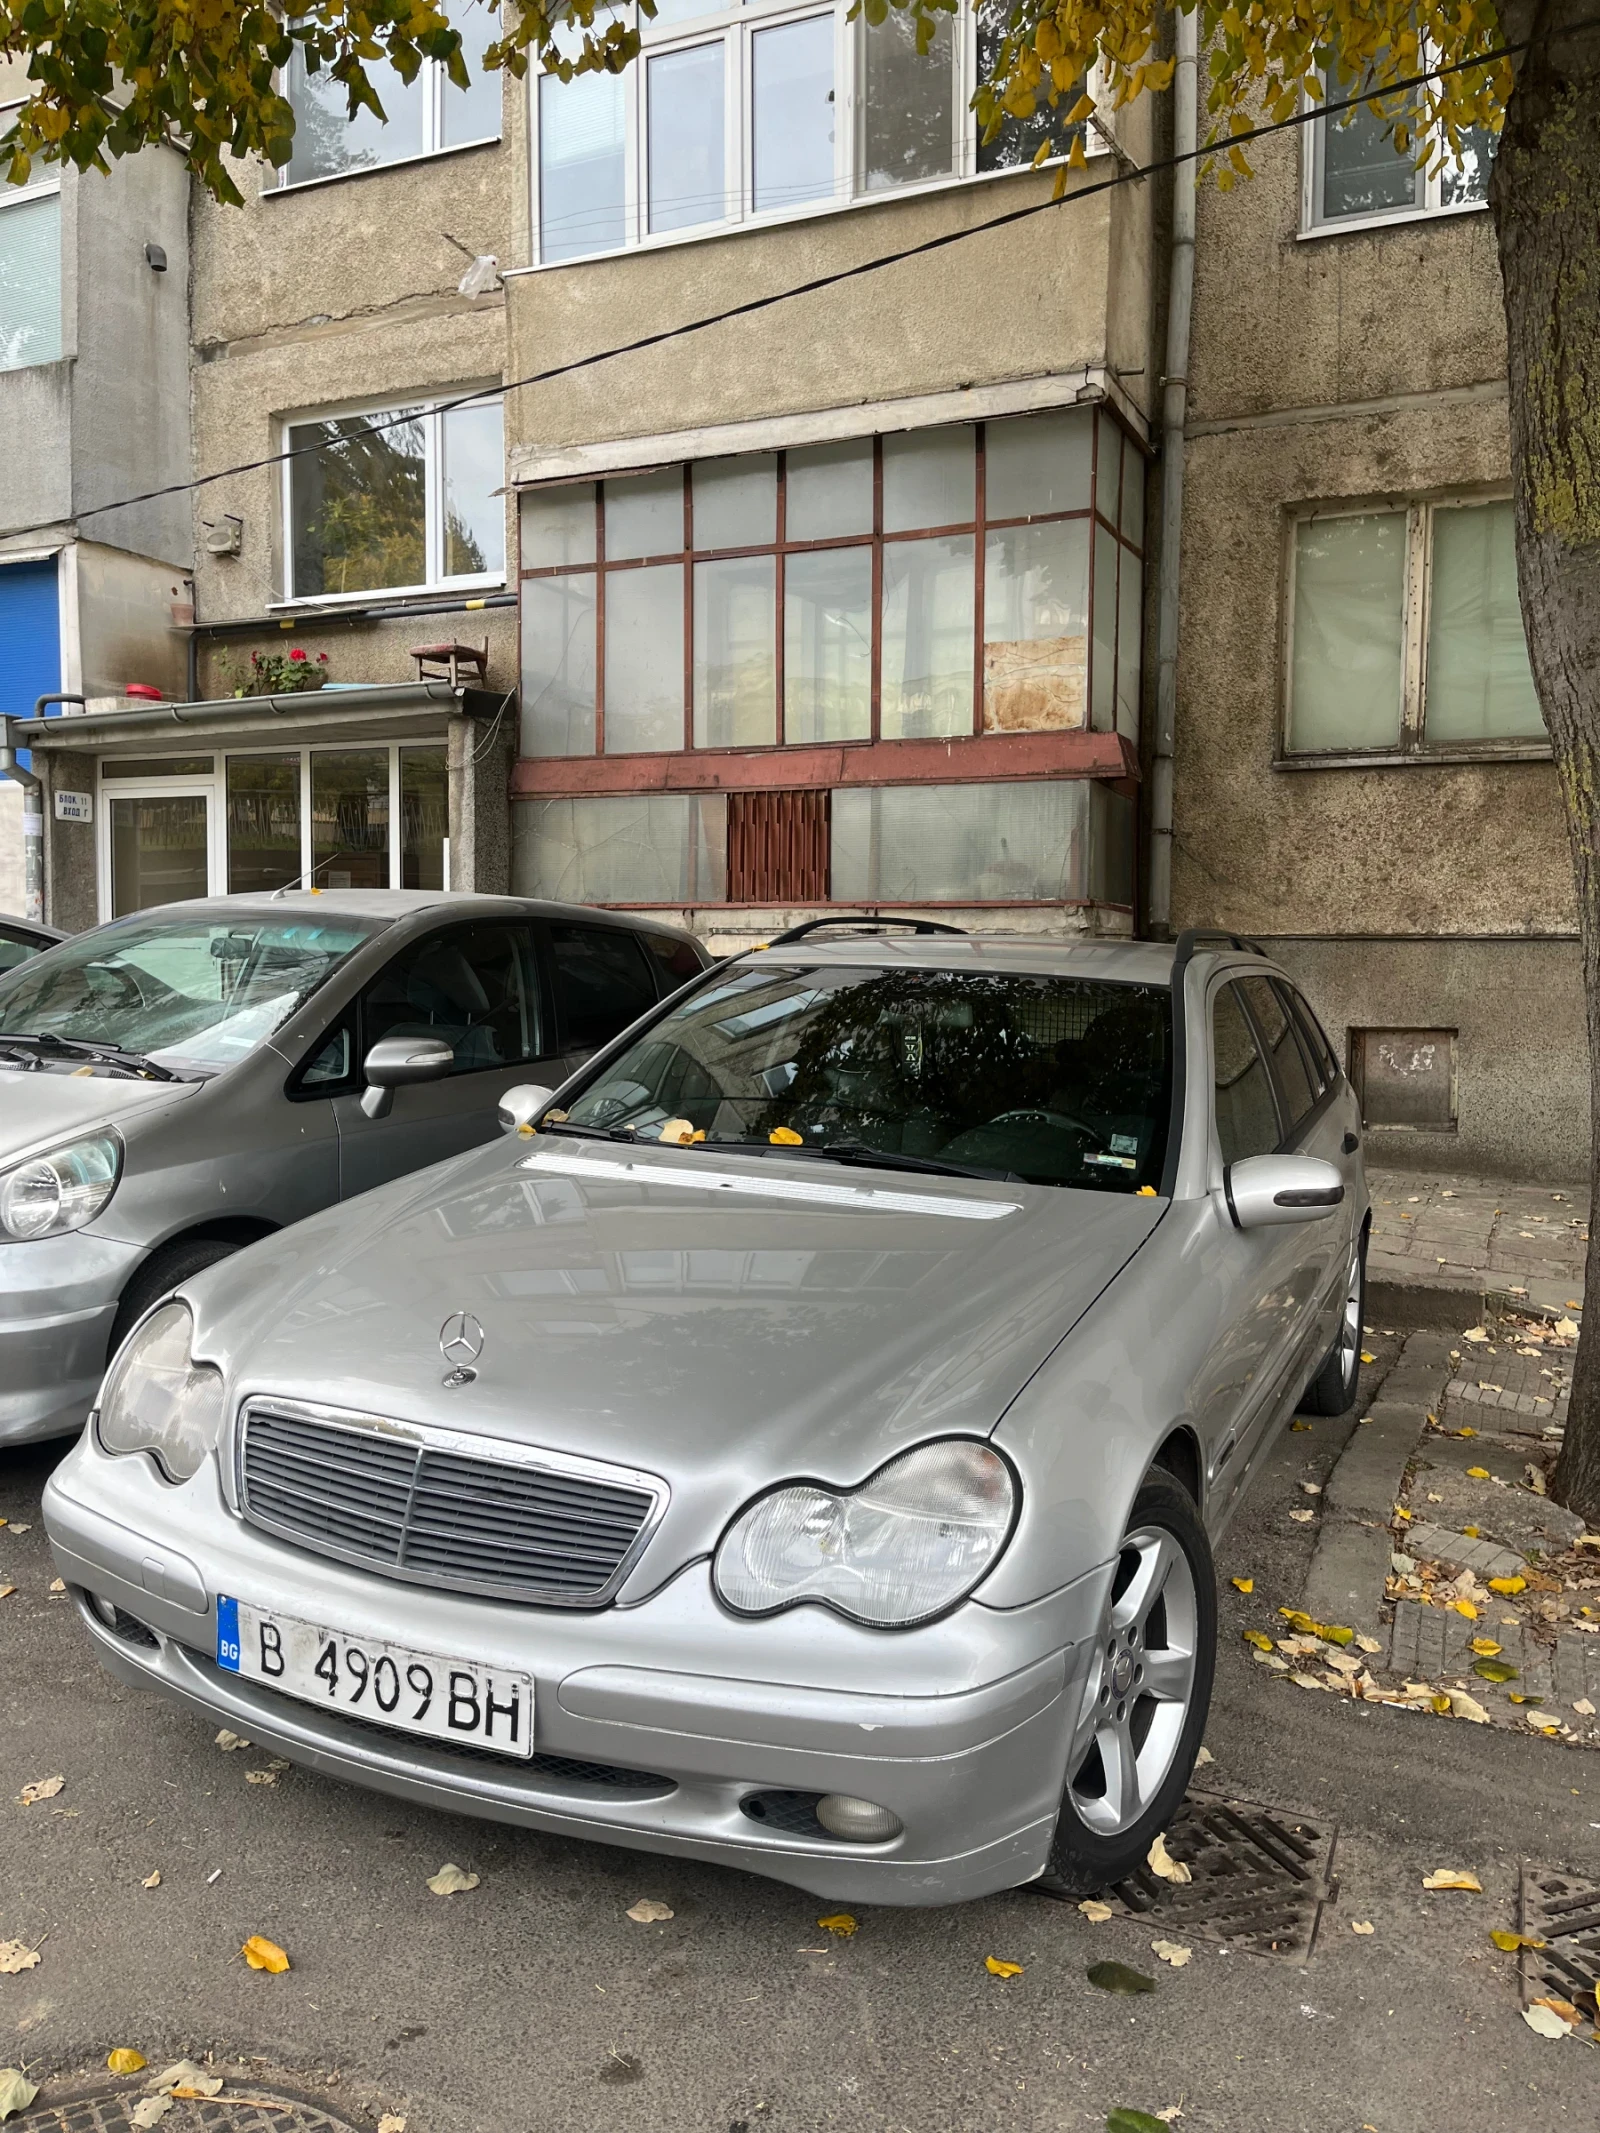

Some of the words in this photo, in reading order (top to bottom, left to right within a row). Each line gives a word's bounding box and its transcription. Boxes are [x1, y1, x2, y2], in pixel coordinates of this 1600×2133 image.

[59, 794, 77, 804] БЛОК
[63, 806, 81, 817] ВХОД
[220, 1639, 239, 1661] BG
[314, 1639, 433, 1721] 4909
